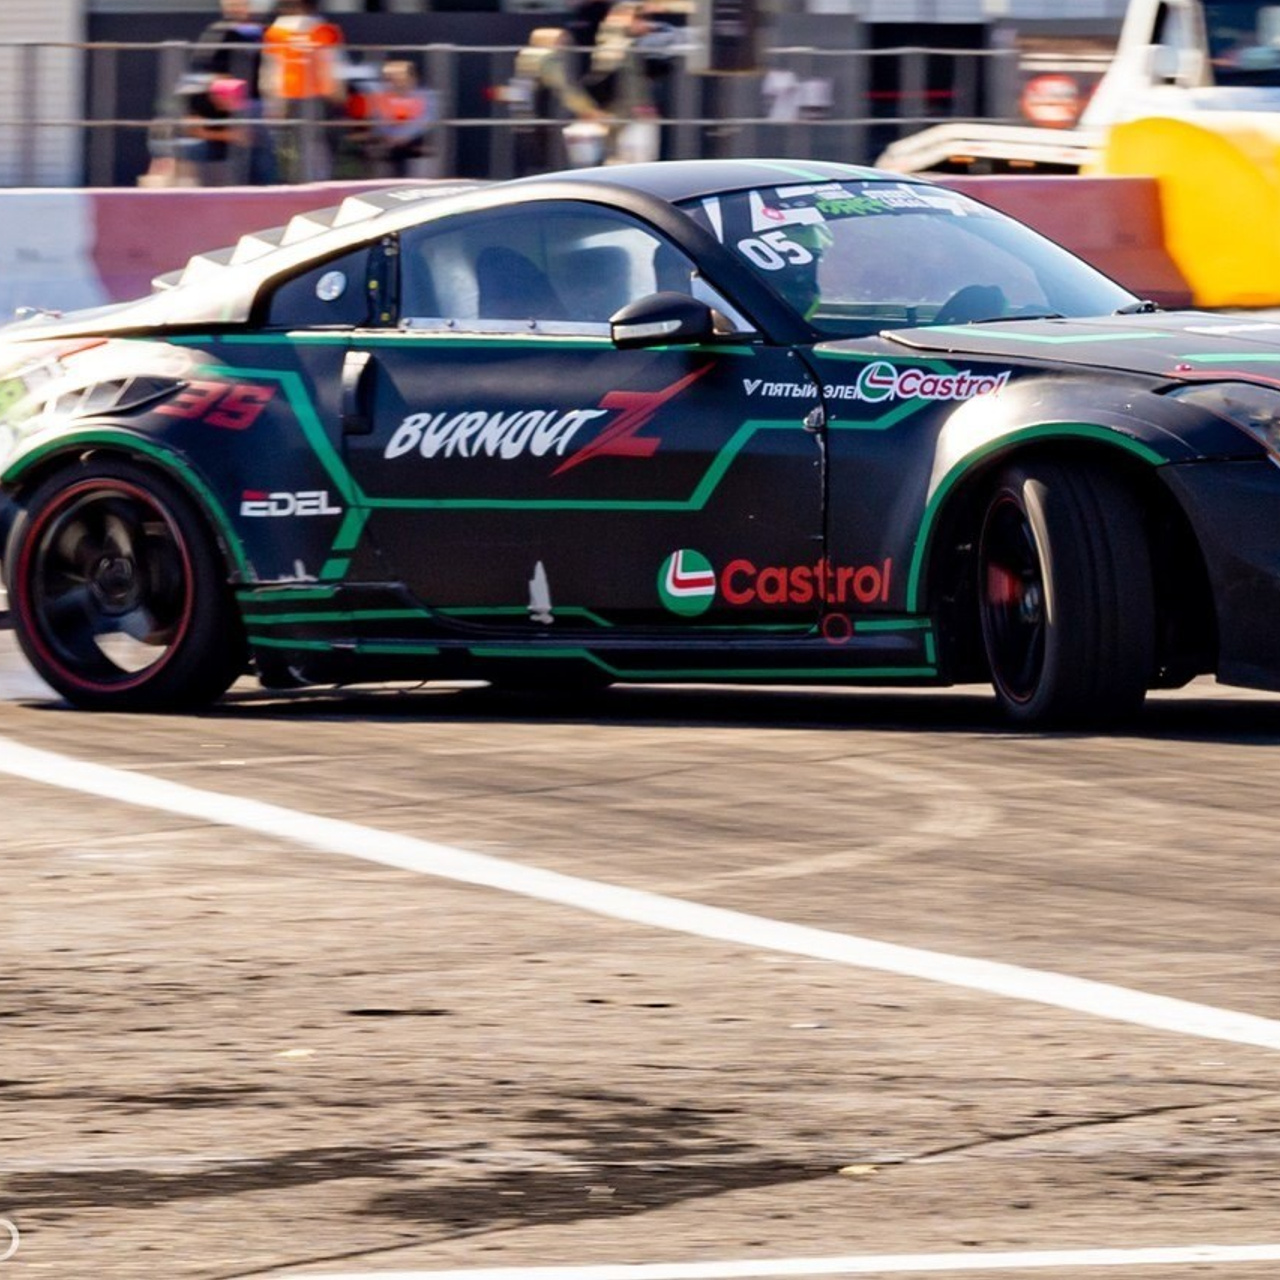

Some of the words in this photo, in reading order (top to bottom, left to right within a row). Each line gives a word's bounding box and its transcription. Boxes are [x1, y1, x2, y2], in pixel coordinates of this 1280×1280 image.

[737, 231, 813, 271] 05
[761, 382, 818, 398] ПЯТЫЙ
[896, 369, 1011, 399] Castrol
[384, 409, 608, 459] BURNOUT
[240, 490, 342, 517] EDEL
[721, 557, 892, 604] Castrol
